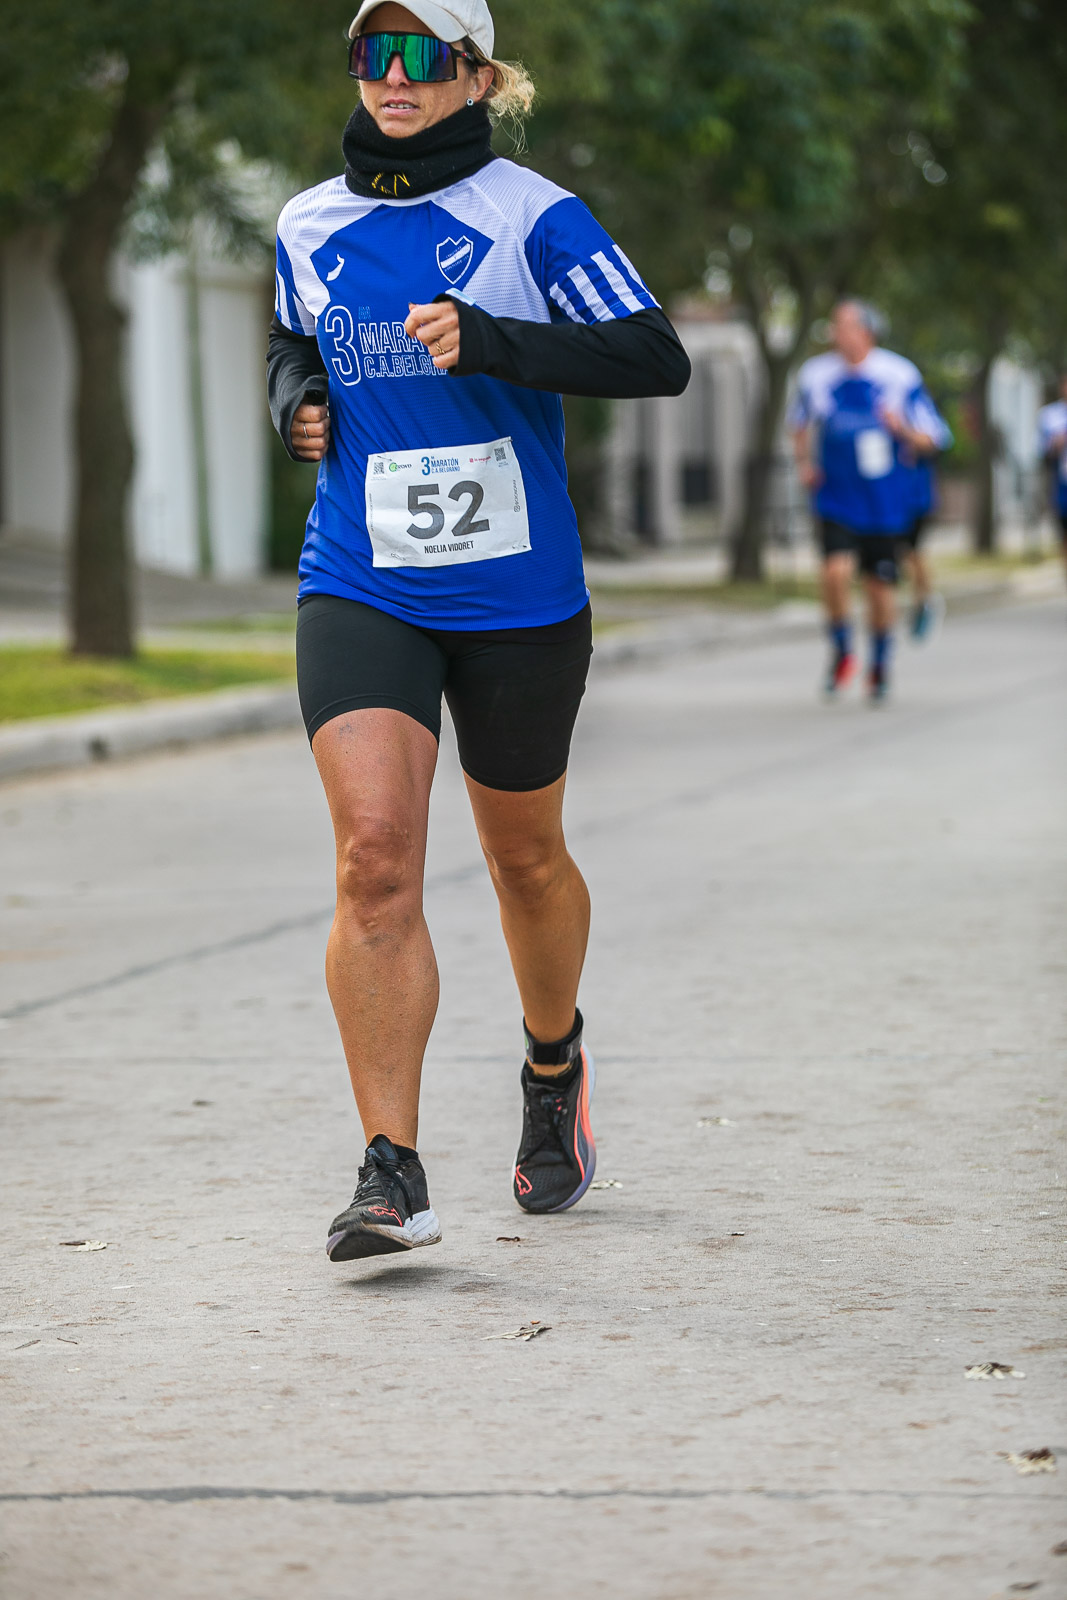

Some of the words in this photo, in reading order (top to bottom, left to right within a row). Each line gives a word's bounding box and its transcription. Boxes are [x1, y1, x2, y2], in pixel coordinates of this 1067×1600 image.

[324, 305, 361, 387] 3
[358, 321, 425, 354] MARA
[421, 456, 431, 476] 3
[431, 457, 459, 468] MARATÓN
[406, 480, 490, 540] 52
[424, 544, 447, 554] NOELIA
[448, 540, 474, 552] VIDORET
